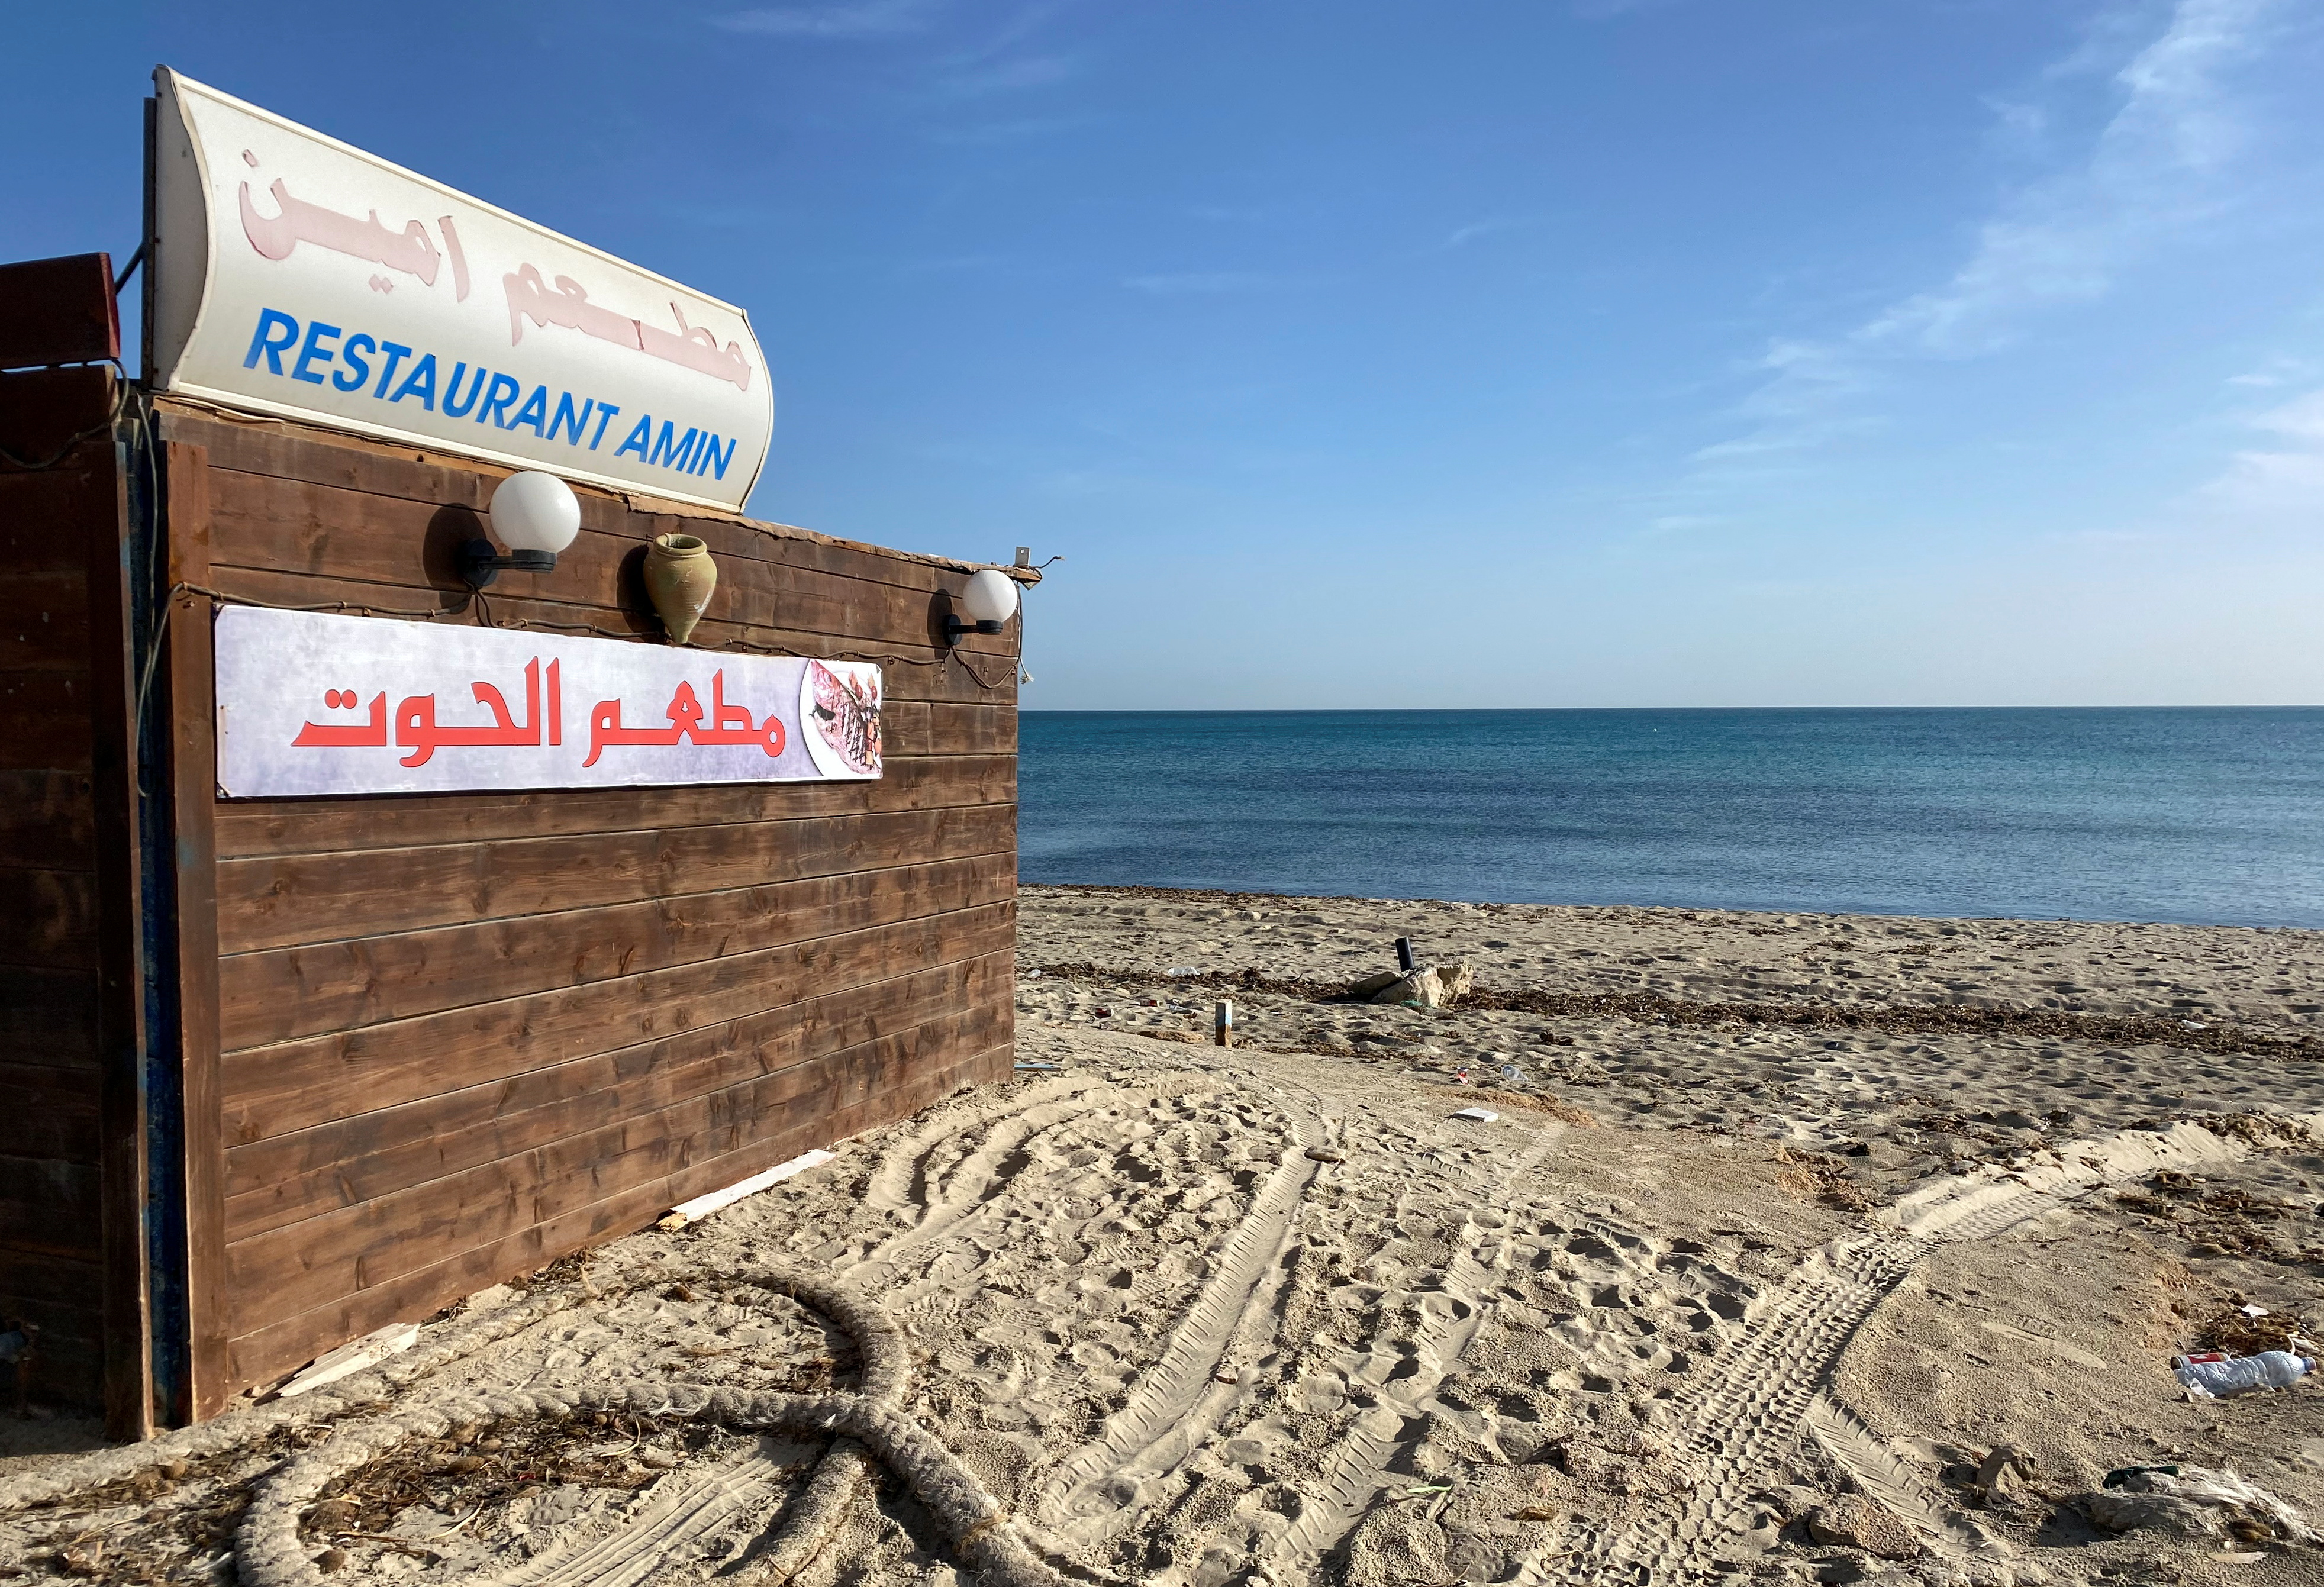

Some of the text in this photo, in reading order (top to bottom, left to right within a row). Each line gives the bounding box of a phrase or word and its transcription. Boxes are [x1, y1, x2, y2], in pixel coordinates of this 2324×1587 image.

[503, 262, 751, 391] مطعم
[243, 307, 737, 480] RESTAURANT AMIN
[291, 656, 786, 768] مطعم الحوت
